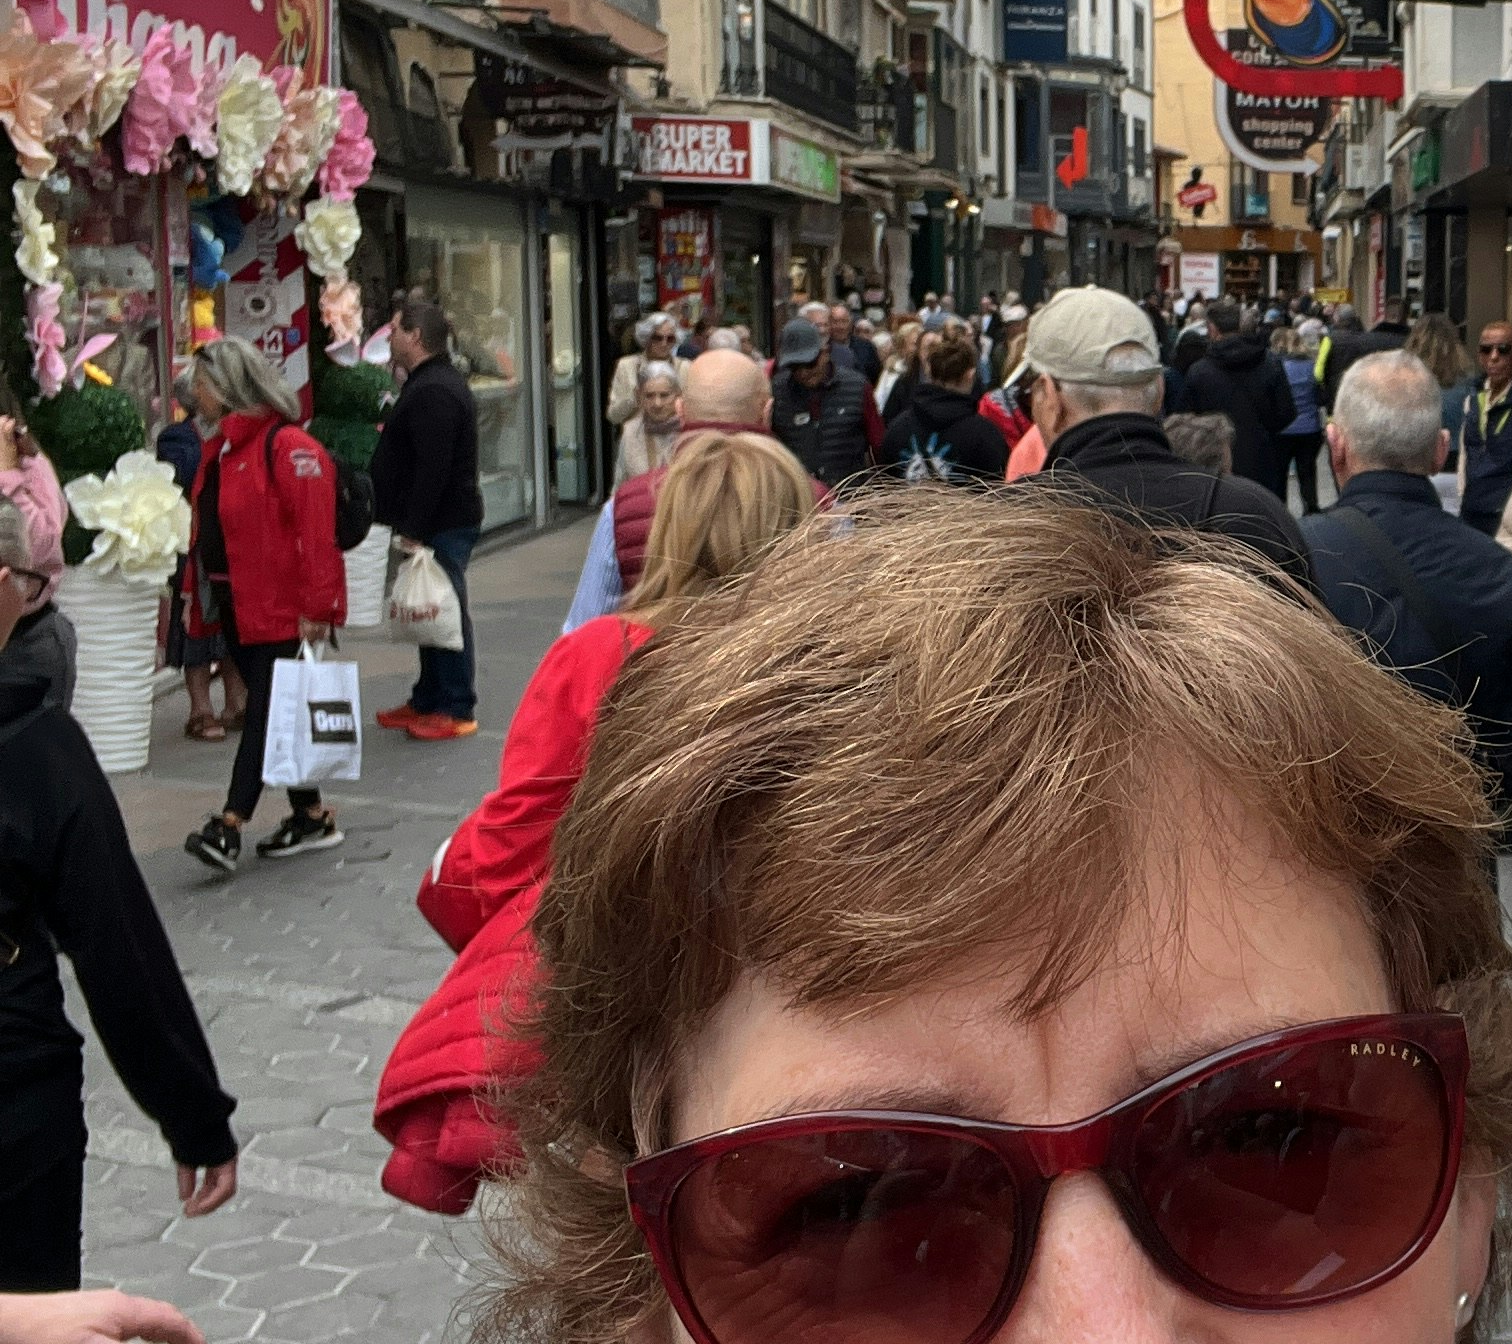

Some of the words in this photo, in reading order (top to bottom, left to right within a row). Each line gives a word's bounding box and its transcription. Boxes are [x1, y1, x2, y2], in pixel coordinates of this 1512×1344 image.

[651, 123, 732, 151] SUPER
[1242, 119, 1314, 136] shopping
[660, 149, 748, 175] MARKET
[1350, 1042, 1421, 1067] RADLEY
